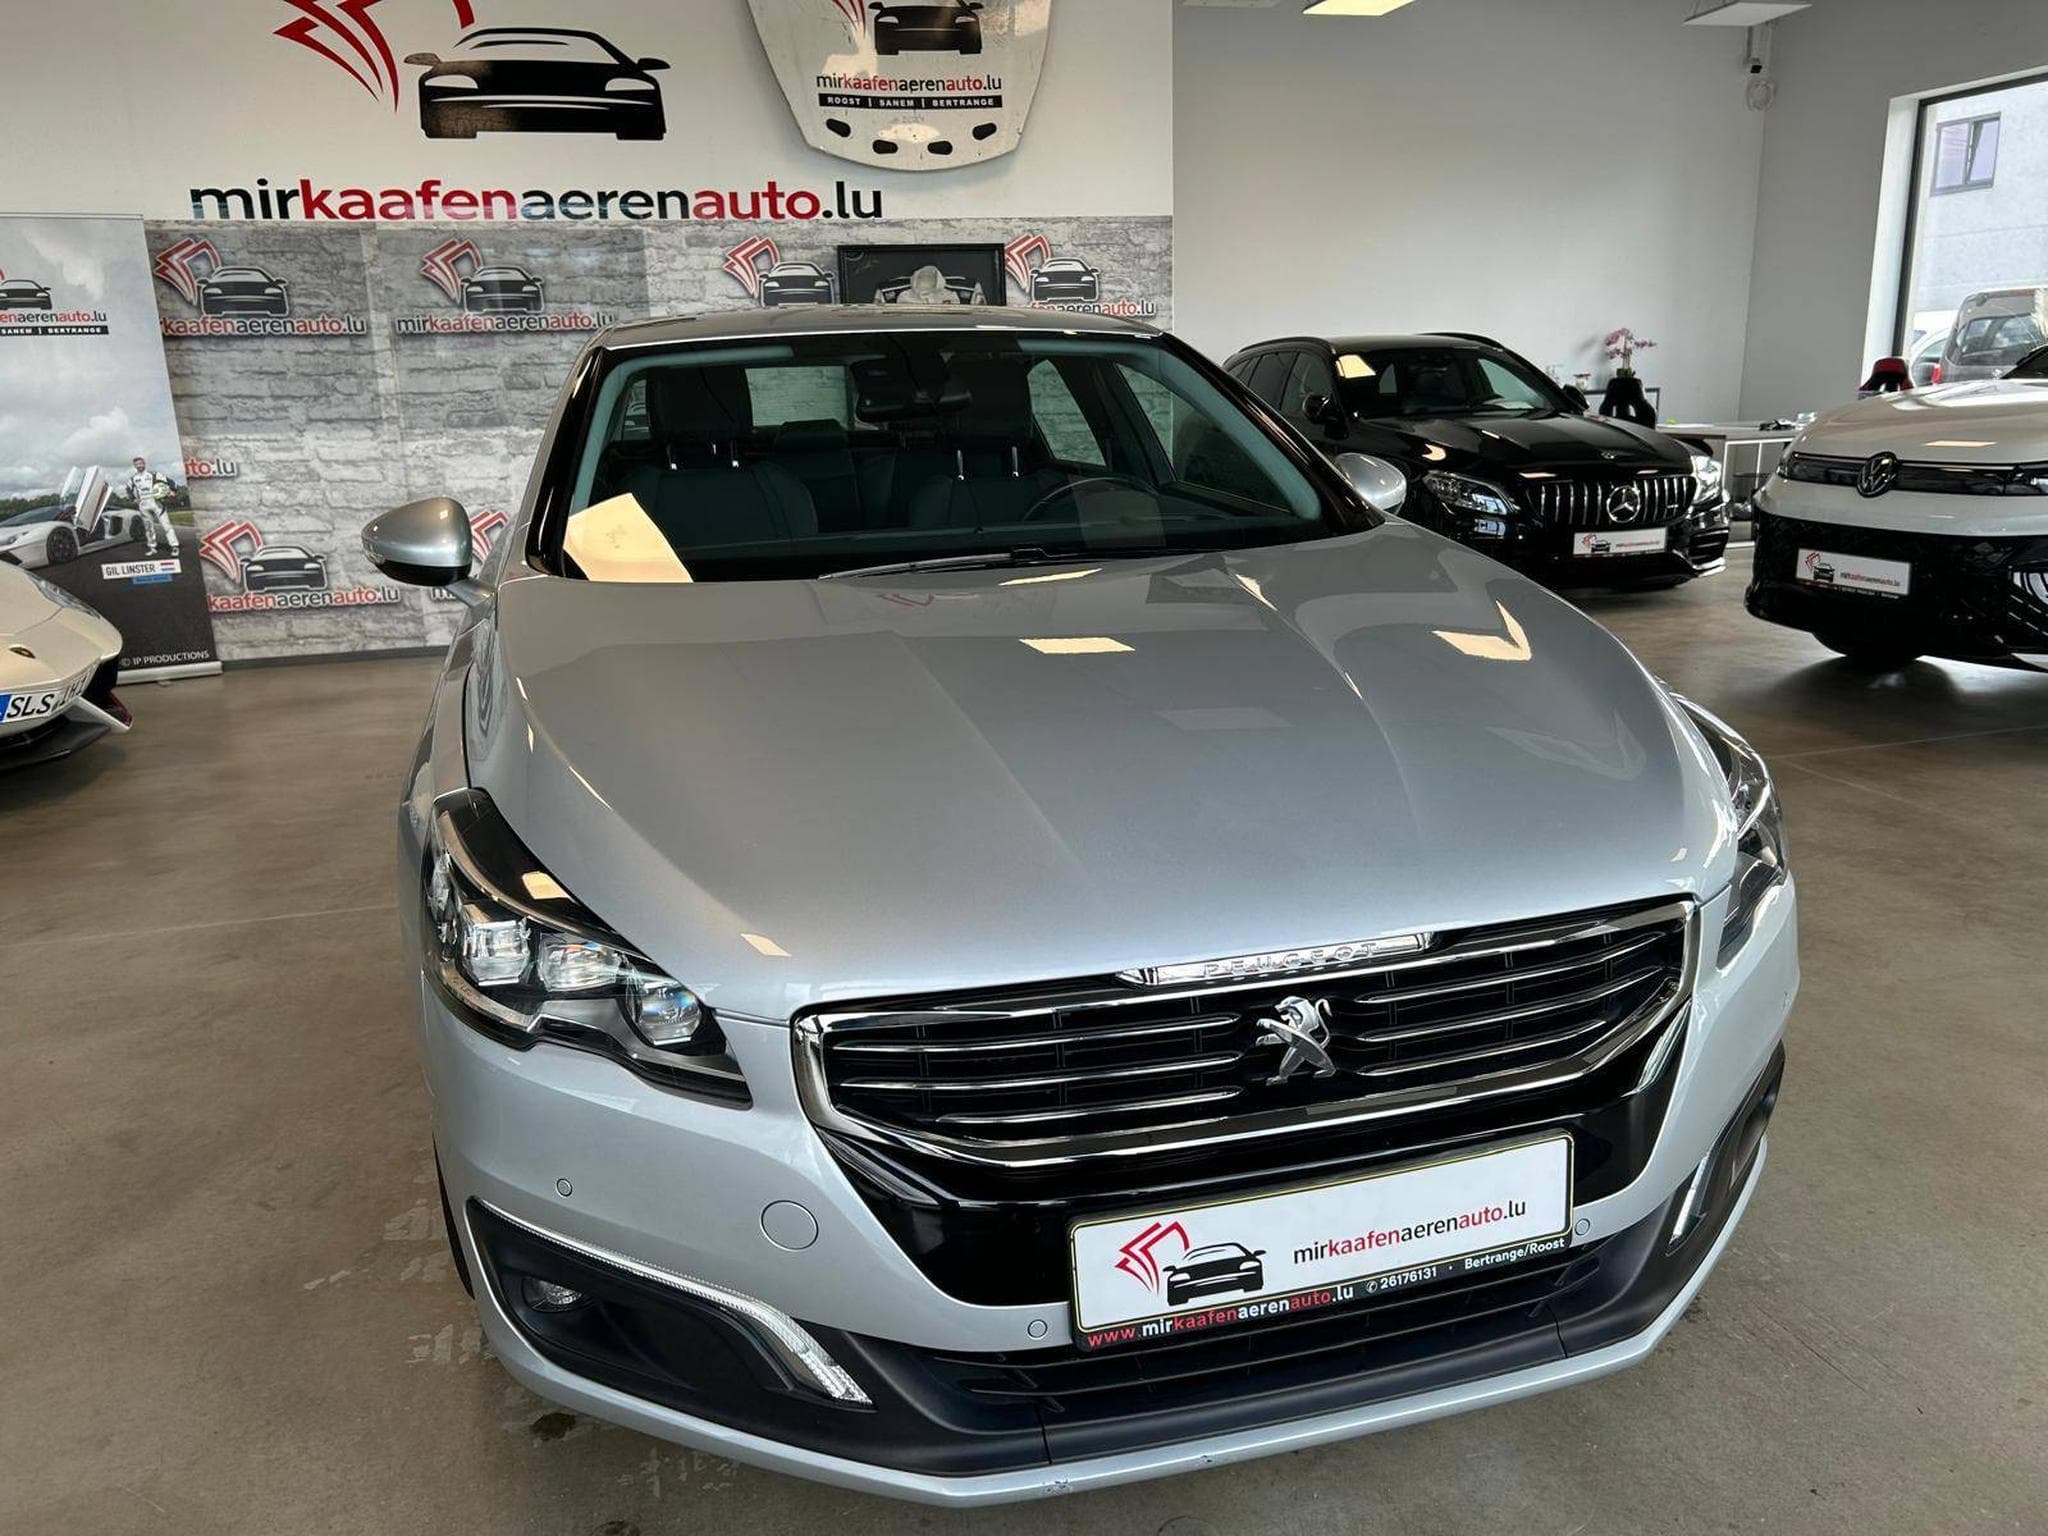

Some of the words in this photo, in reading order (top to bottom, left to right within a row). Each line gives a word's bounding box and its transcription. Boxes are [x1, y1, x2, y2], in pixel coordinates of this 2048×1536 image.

[816, 72, 1002, 93] mirkaafenaerenauto.lu
[827, 96, 861, 106] ROOST
[879, 98, 914, 107] SANEM
[932, 98, 994, 108] BERTRANGE
[190, 178, 883, 221] mirkaafenaerenauto.lu
[47, 326, 101, 335] BERTRANGE
[105, 566, 120, 576] GIL
[121, 563, 156, 575] LINSTER
[143, 650, 210, 664] PRODUCTIONS
[6, 693, 56, 719] SLS
[1203, 942, 1377, 978] PEUGEOT
[1293, 1200, 1528, 1265] mirkaafenaerenauto.lu
[1087, 1285, 1355, 1348] www.mirkaafenaerenauto.lu
[1380, 1266, 1437, 1290] 26176131
[1464, 1238, 1565, 1270] Bertrange/Roost
